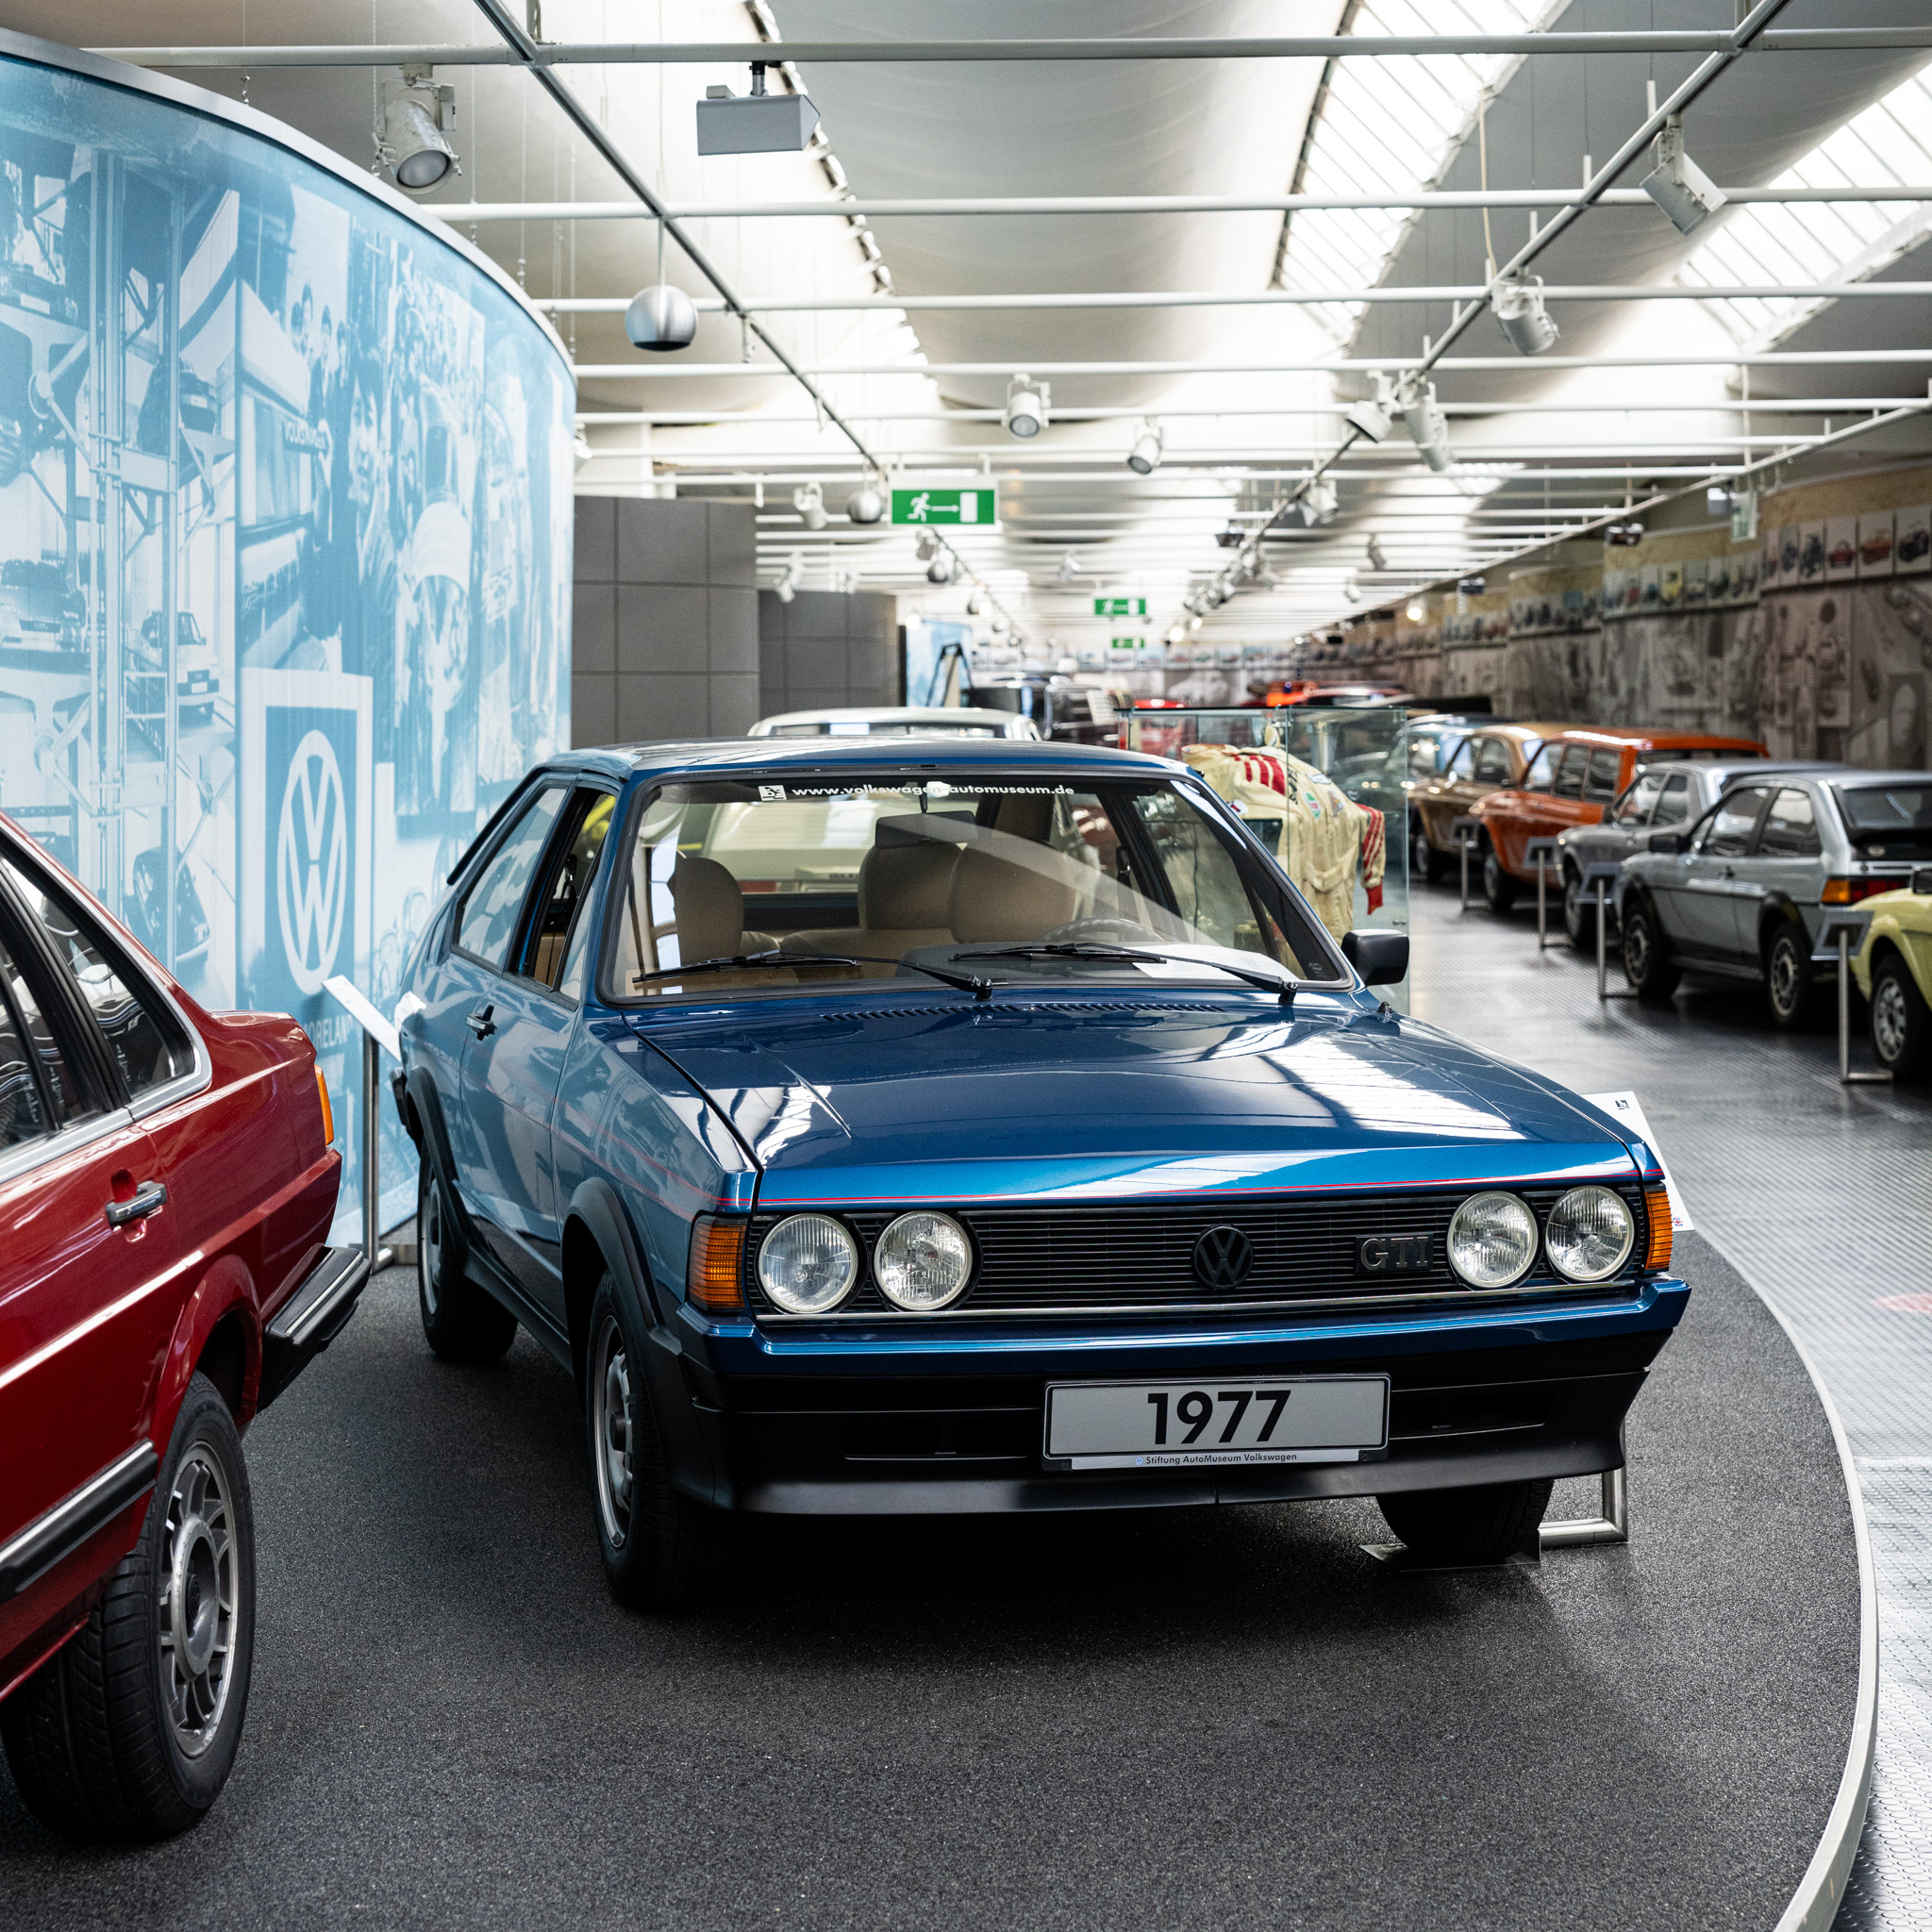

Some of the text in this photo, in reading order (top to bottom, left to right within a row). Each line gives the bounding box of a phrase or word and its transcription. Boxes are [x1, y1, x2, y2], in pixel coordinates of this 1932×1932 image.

[1360, 1236, 1429, 1271] GTI
[1147, 1390, 1291, 1445] 1977
[1146, 1456, 1180, 1465] Stiftung
[1182, 1454, 1241, 1463] AutoMuseum
[1243, 1453, 1297, 1462] Volkswagen
